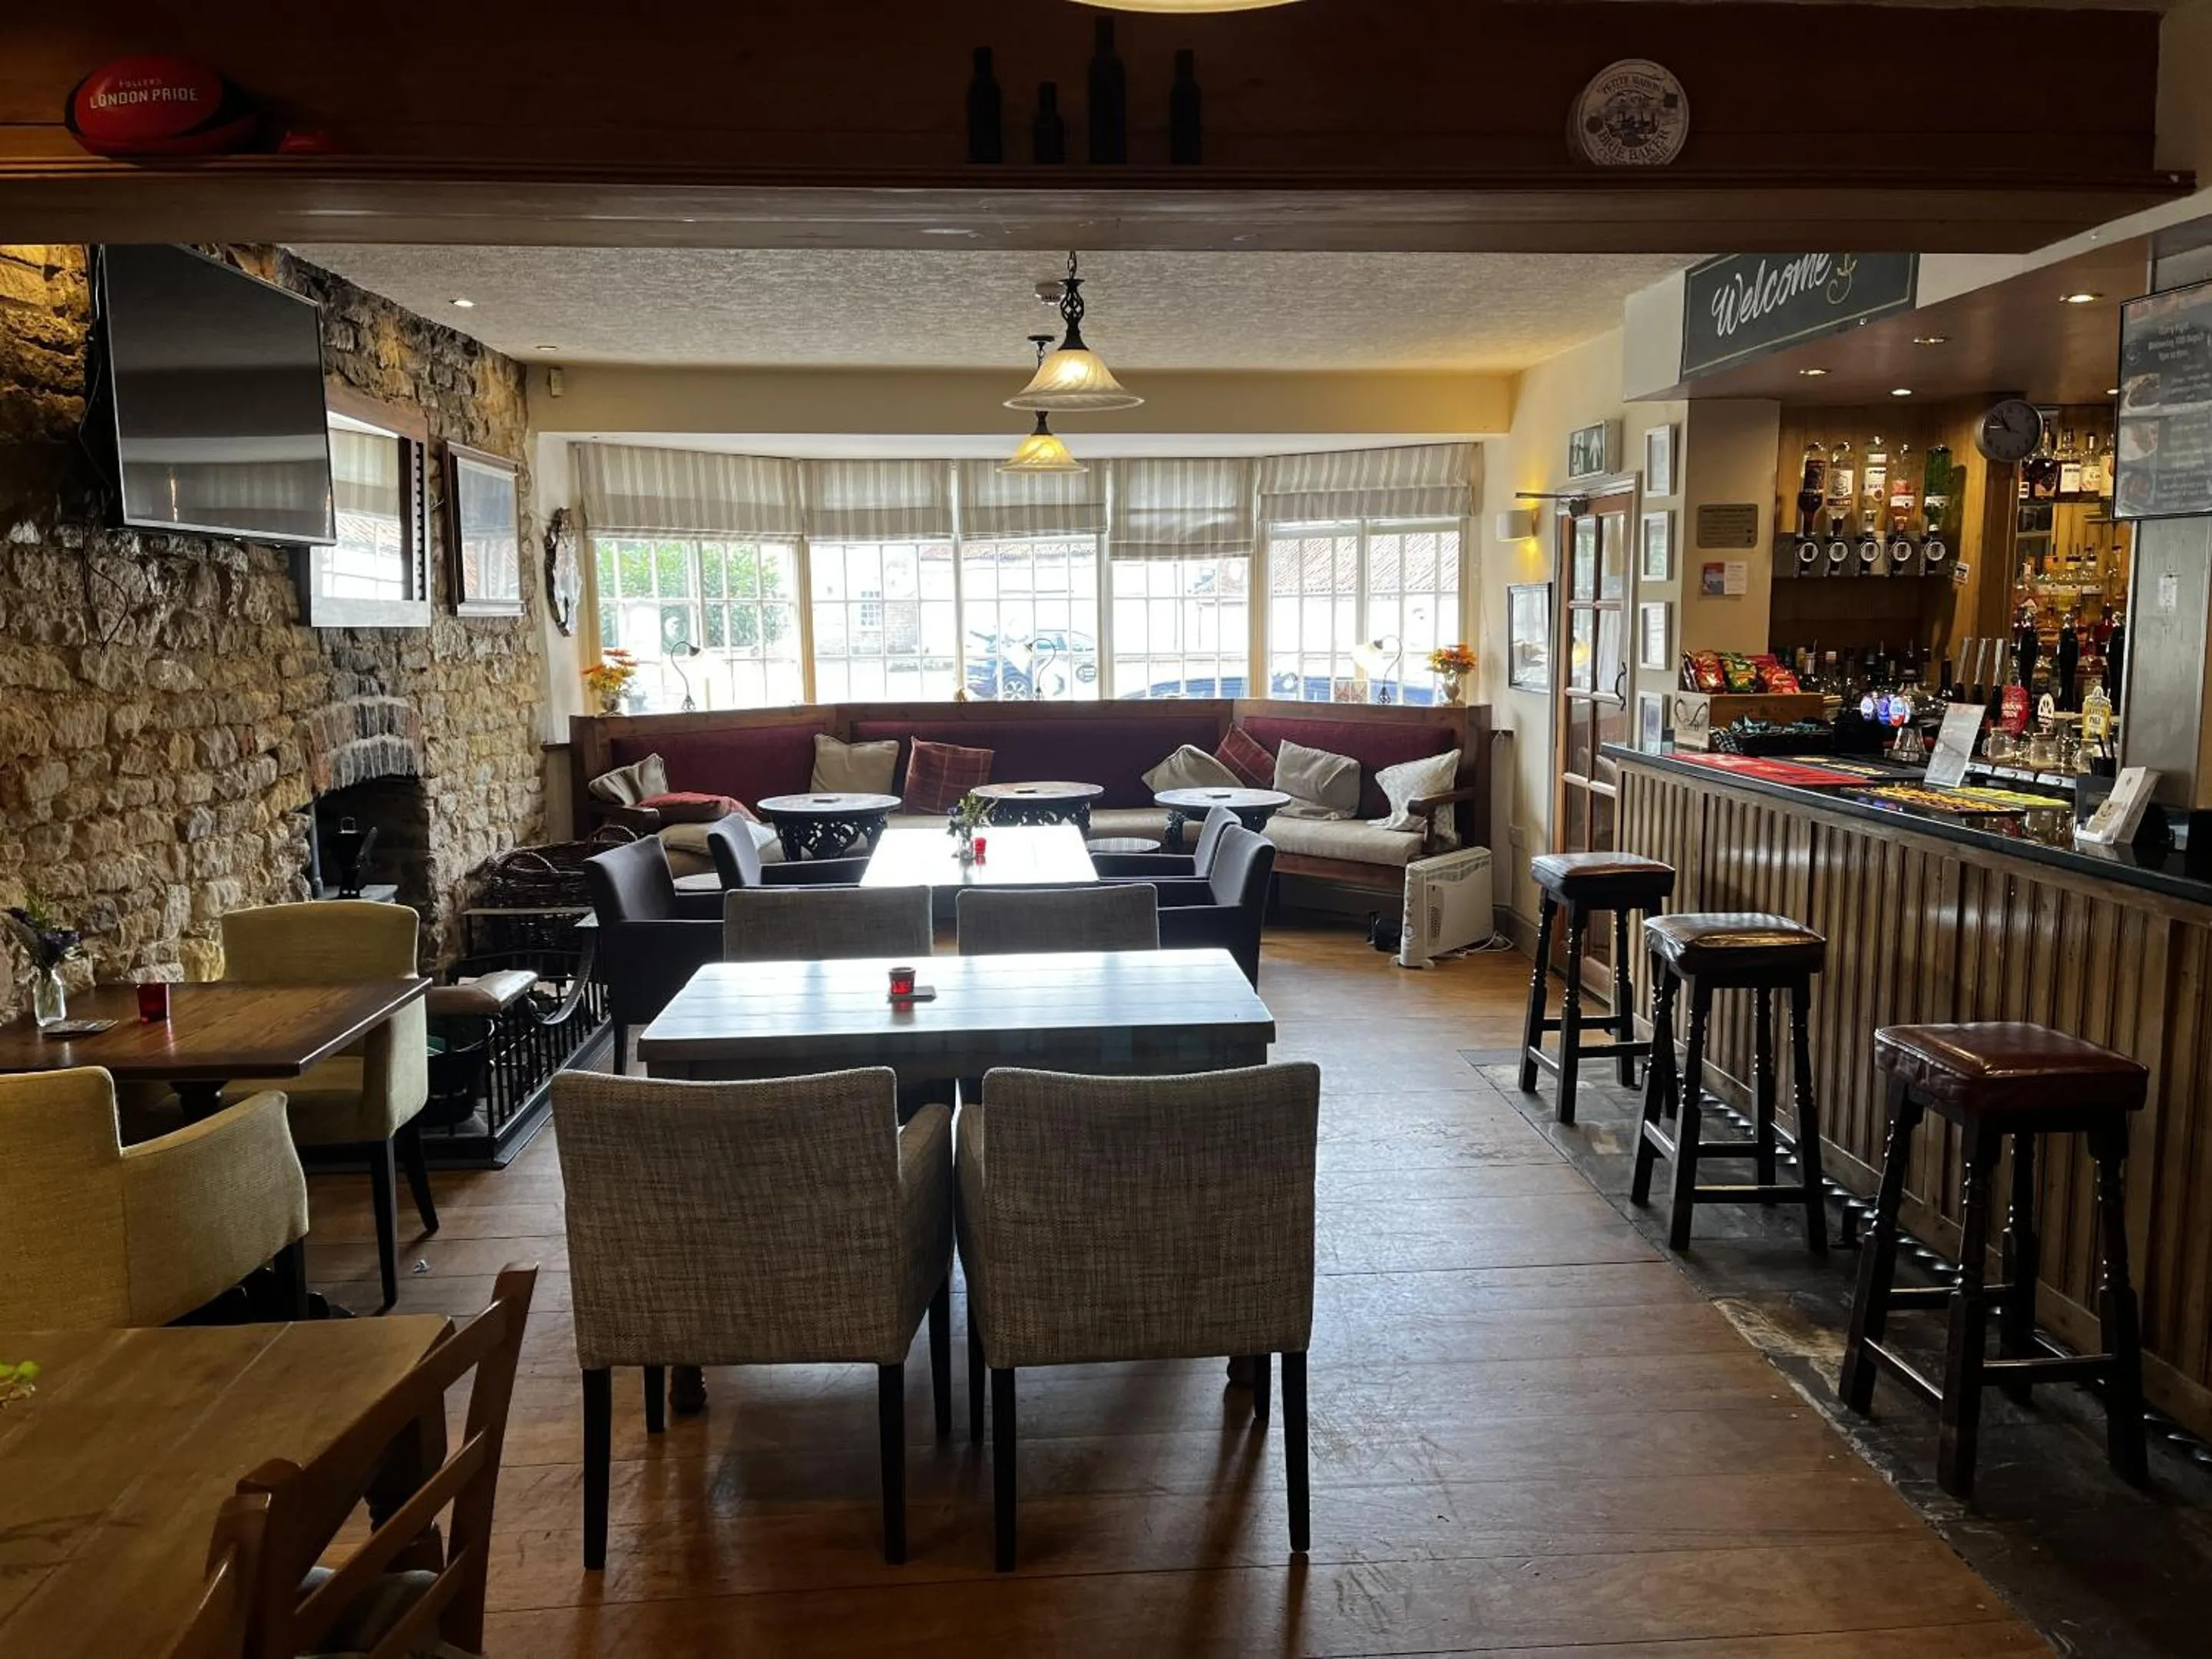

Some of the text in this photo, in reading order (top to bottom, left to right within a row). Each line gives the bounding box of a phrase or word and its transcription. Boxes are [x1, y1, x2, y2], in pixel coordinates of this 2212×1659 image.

[89, 88, 200, 109] LONDON PRIDE
[1711, 253, 1832, 338] Welcome
